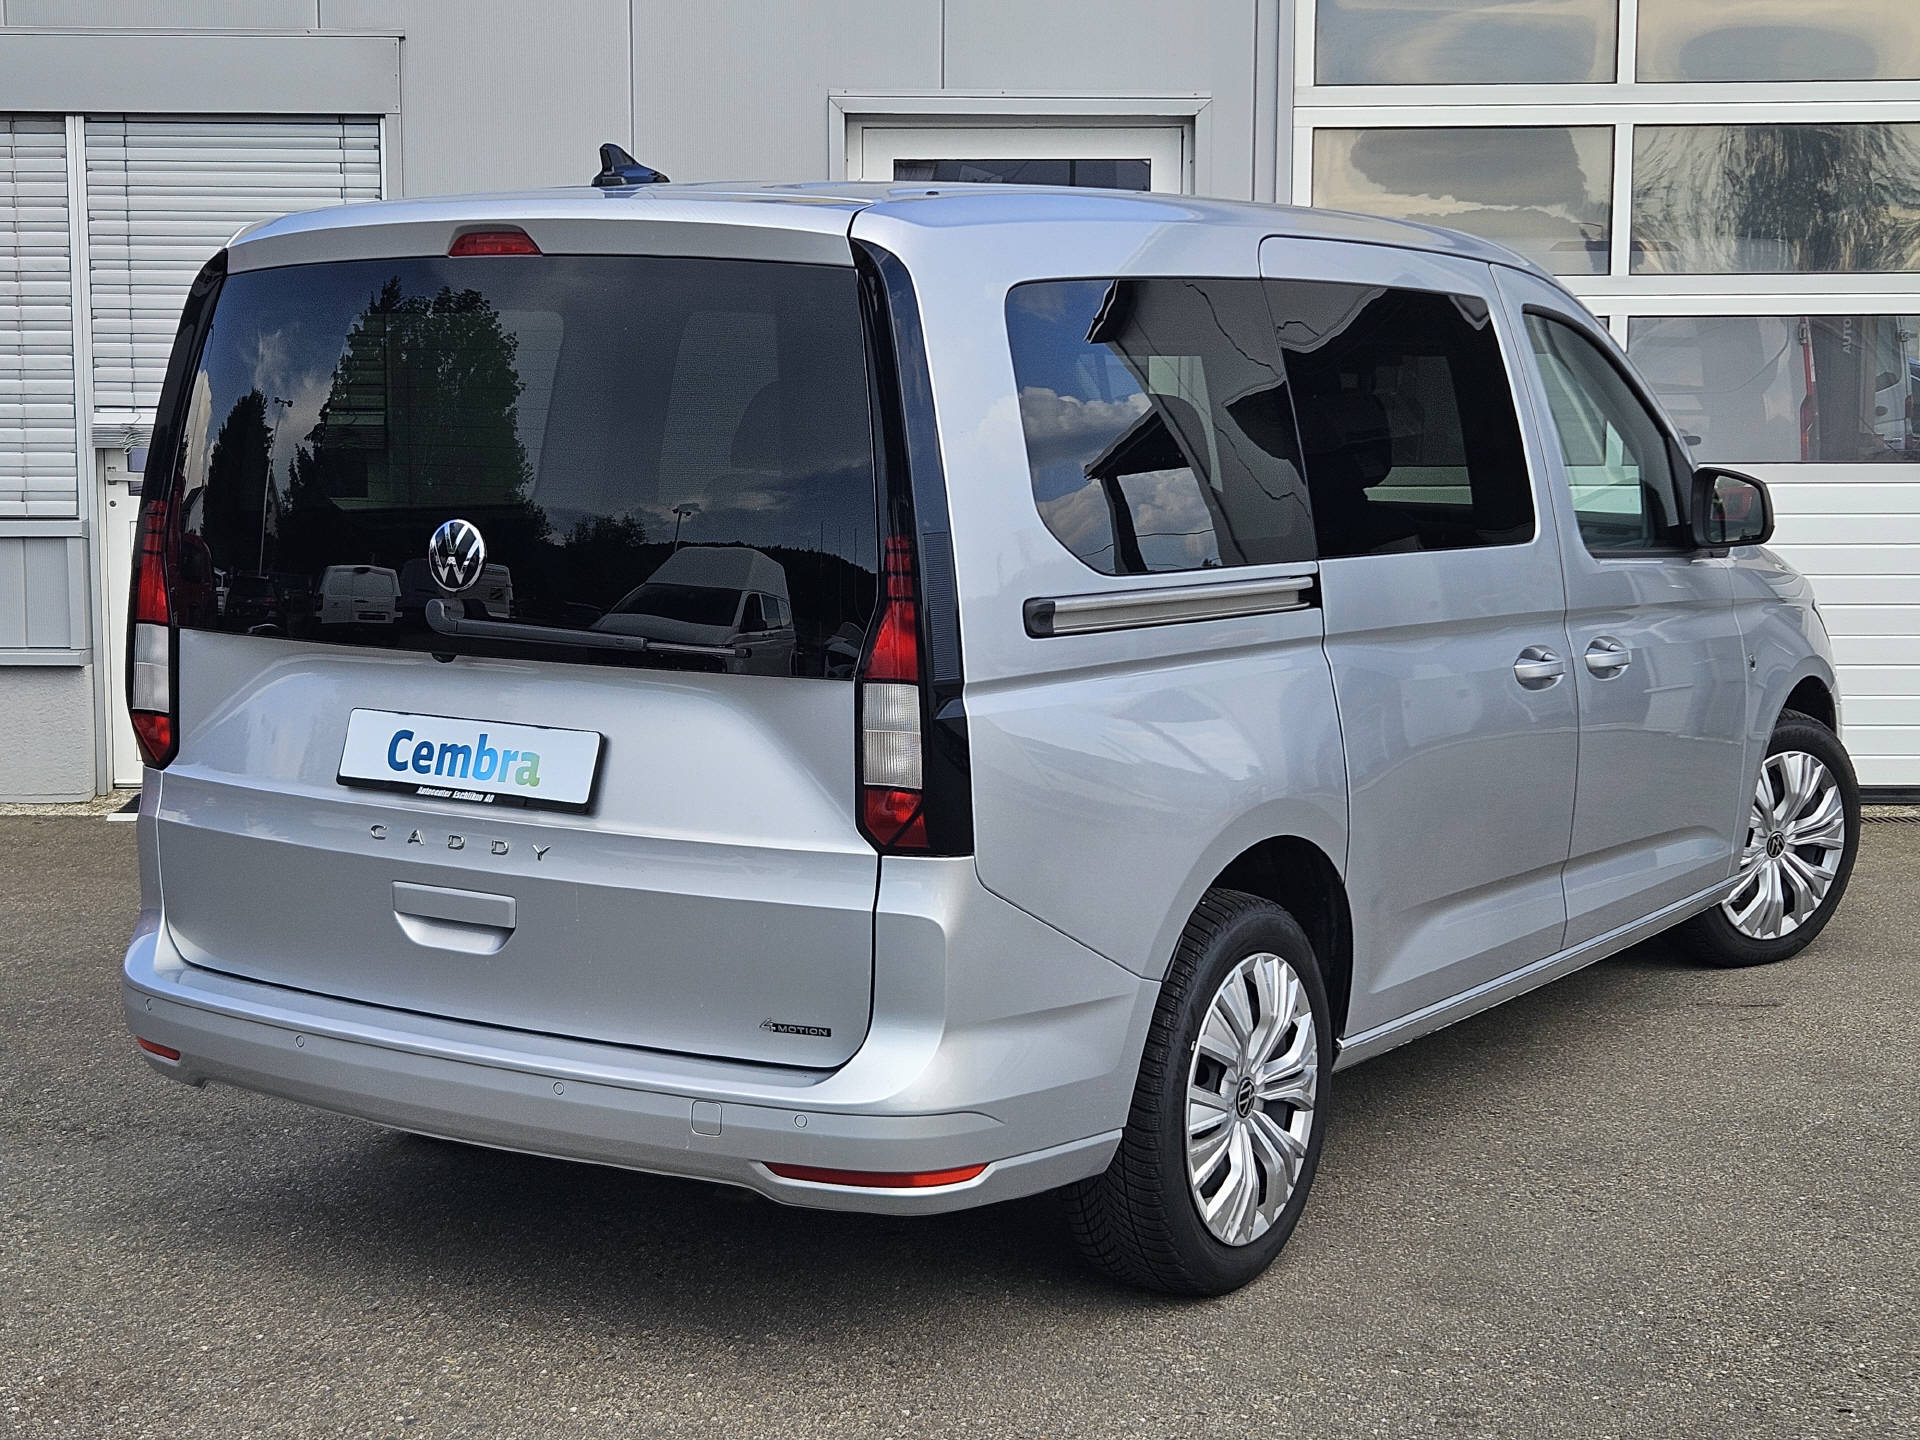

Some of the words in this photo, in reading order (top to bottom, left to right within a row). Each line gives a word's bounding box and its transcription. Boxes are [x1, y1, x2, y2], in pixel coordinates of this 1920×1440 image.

[387, 729, 541, 788] Cembra
[370, 824, 551, 861] CADDY
[760, 1017, 829, 1036] 4MOTION
